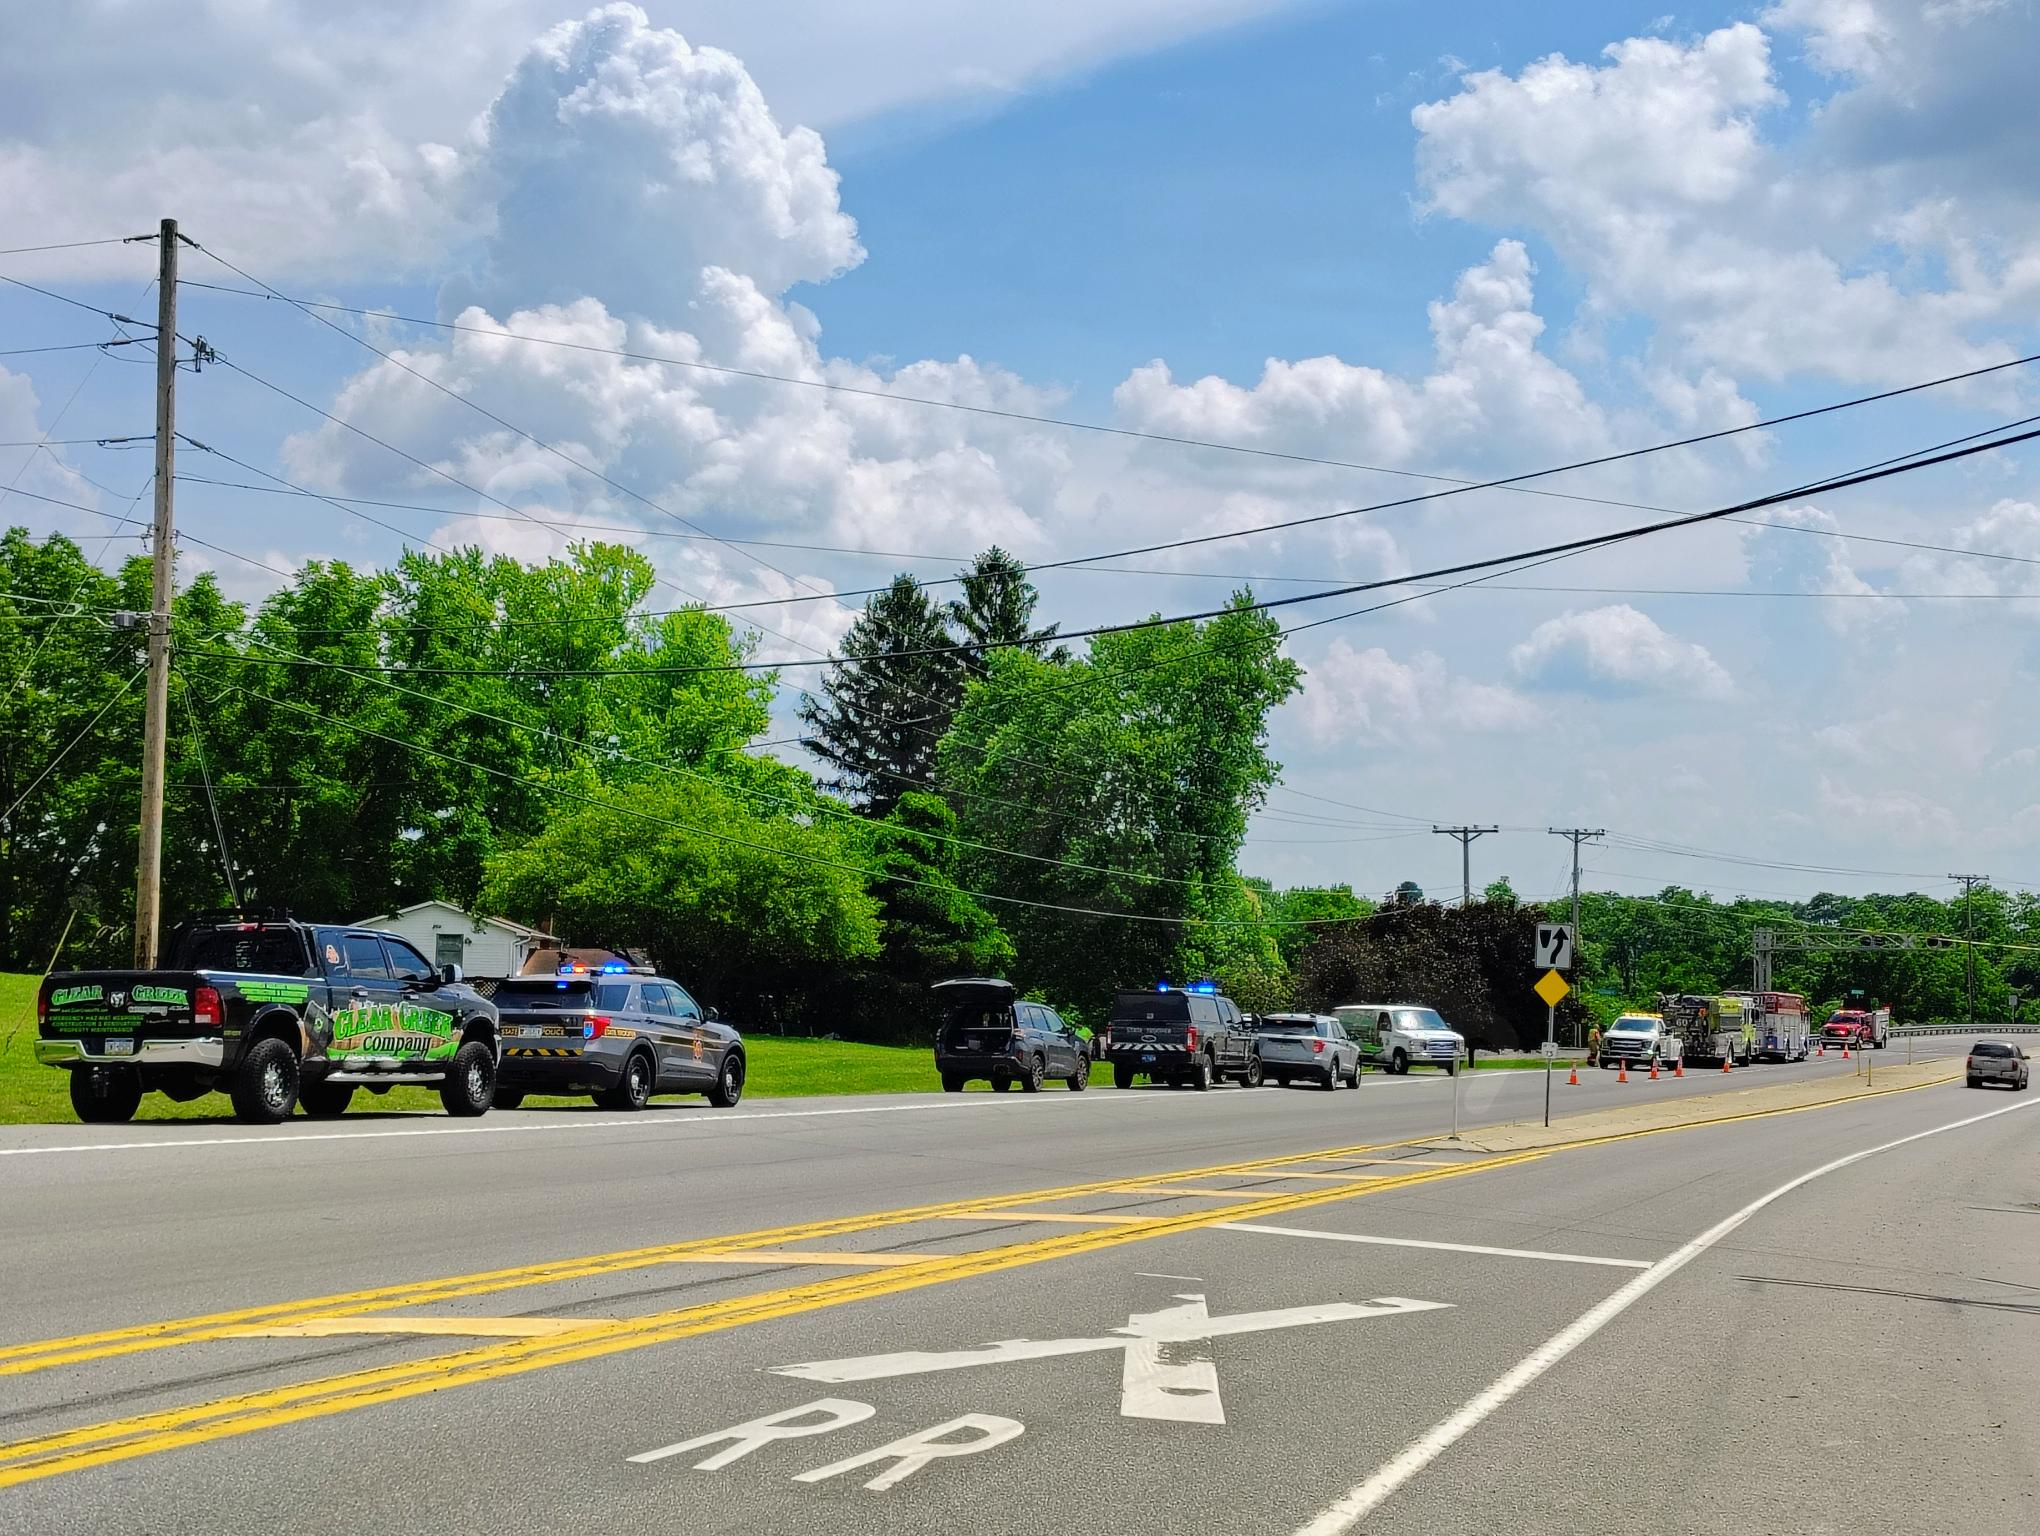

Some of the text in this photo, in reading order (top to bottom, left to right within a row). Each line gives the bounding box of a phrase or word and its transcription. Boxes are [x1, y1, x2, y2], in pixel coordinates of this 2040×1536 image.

[51, 984, 189, 1006] CLEAR CREEK
[333, 1001, 454, 1042] CLEAR CREEK
[501, 1027, 518, 1036] STATE
[363, 1034, 432, 1061] company
